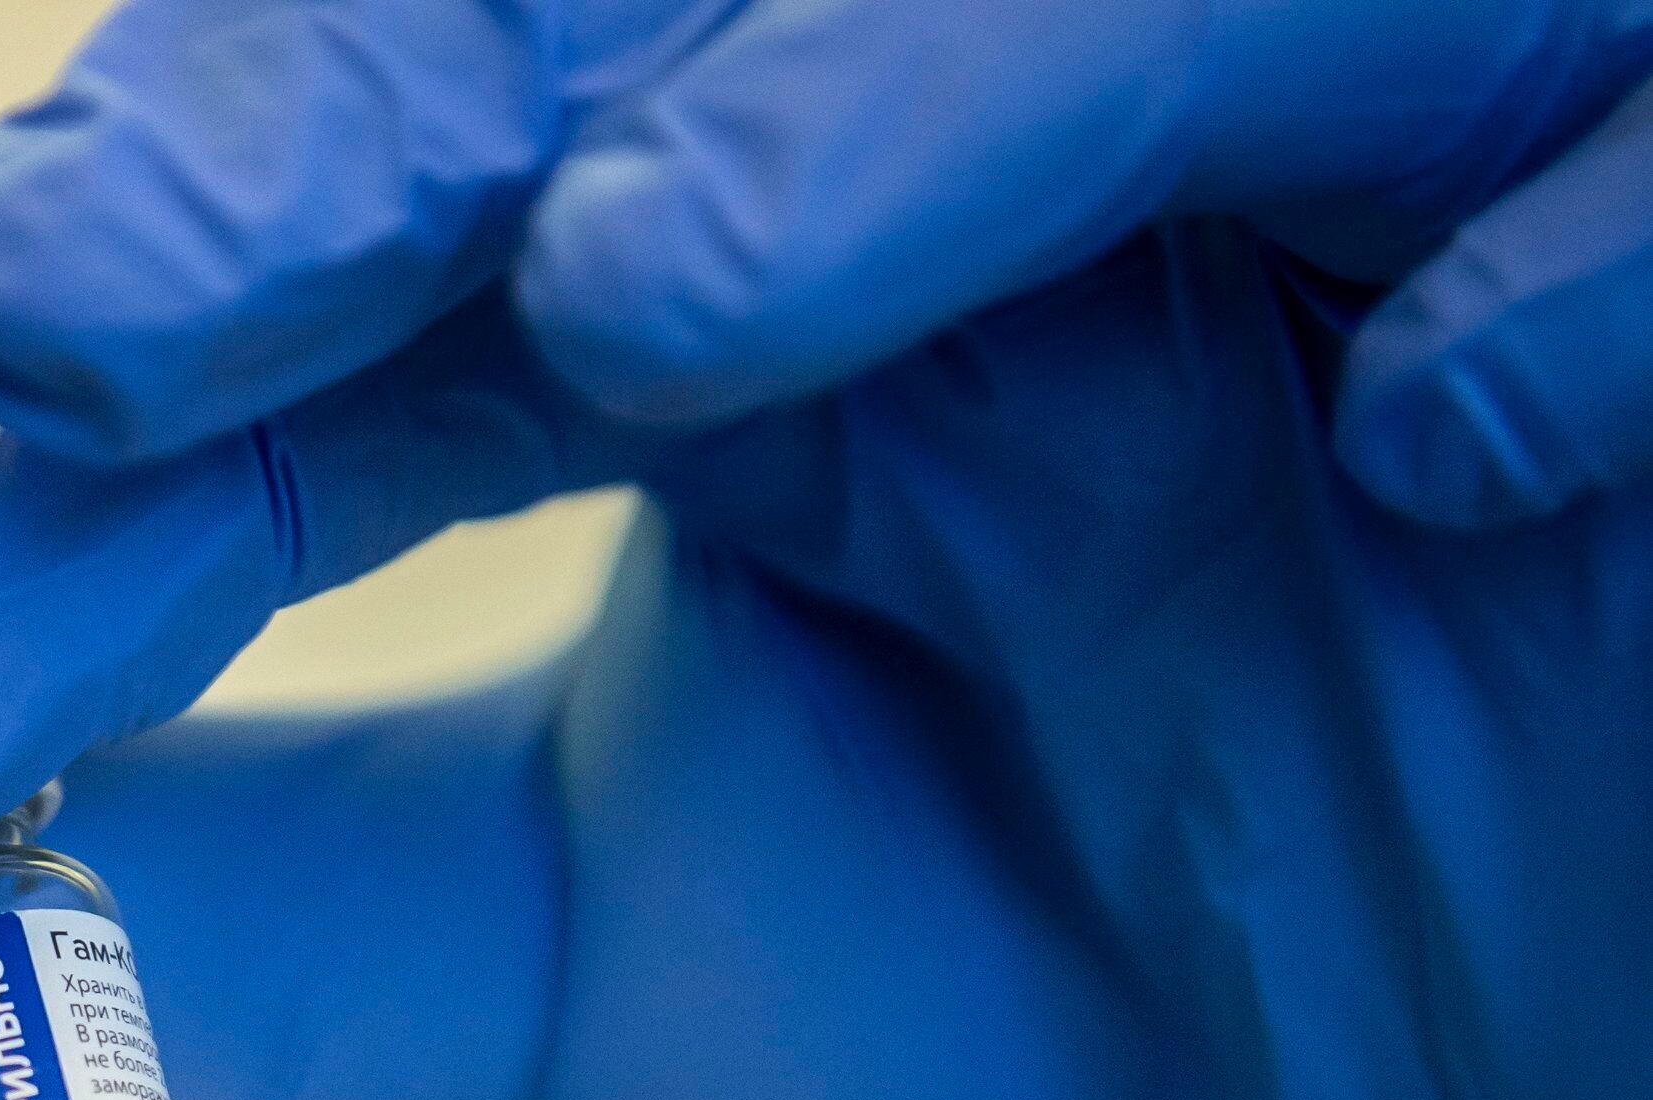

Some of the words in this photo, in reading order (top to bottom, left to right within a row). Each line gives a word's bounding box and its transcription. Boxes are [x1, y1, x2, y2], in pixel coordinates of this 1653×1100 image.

[61, 973, 136, 1004] Хранить
[70, 1003, 110, 1022] при
[75, 1023, 91, 1043] В
[83, 1053, 110, 1068] не
